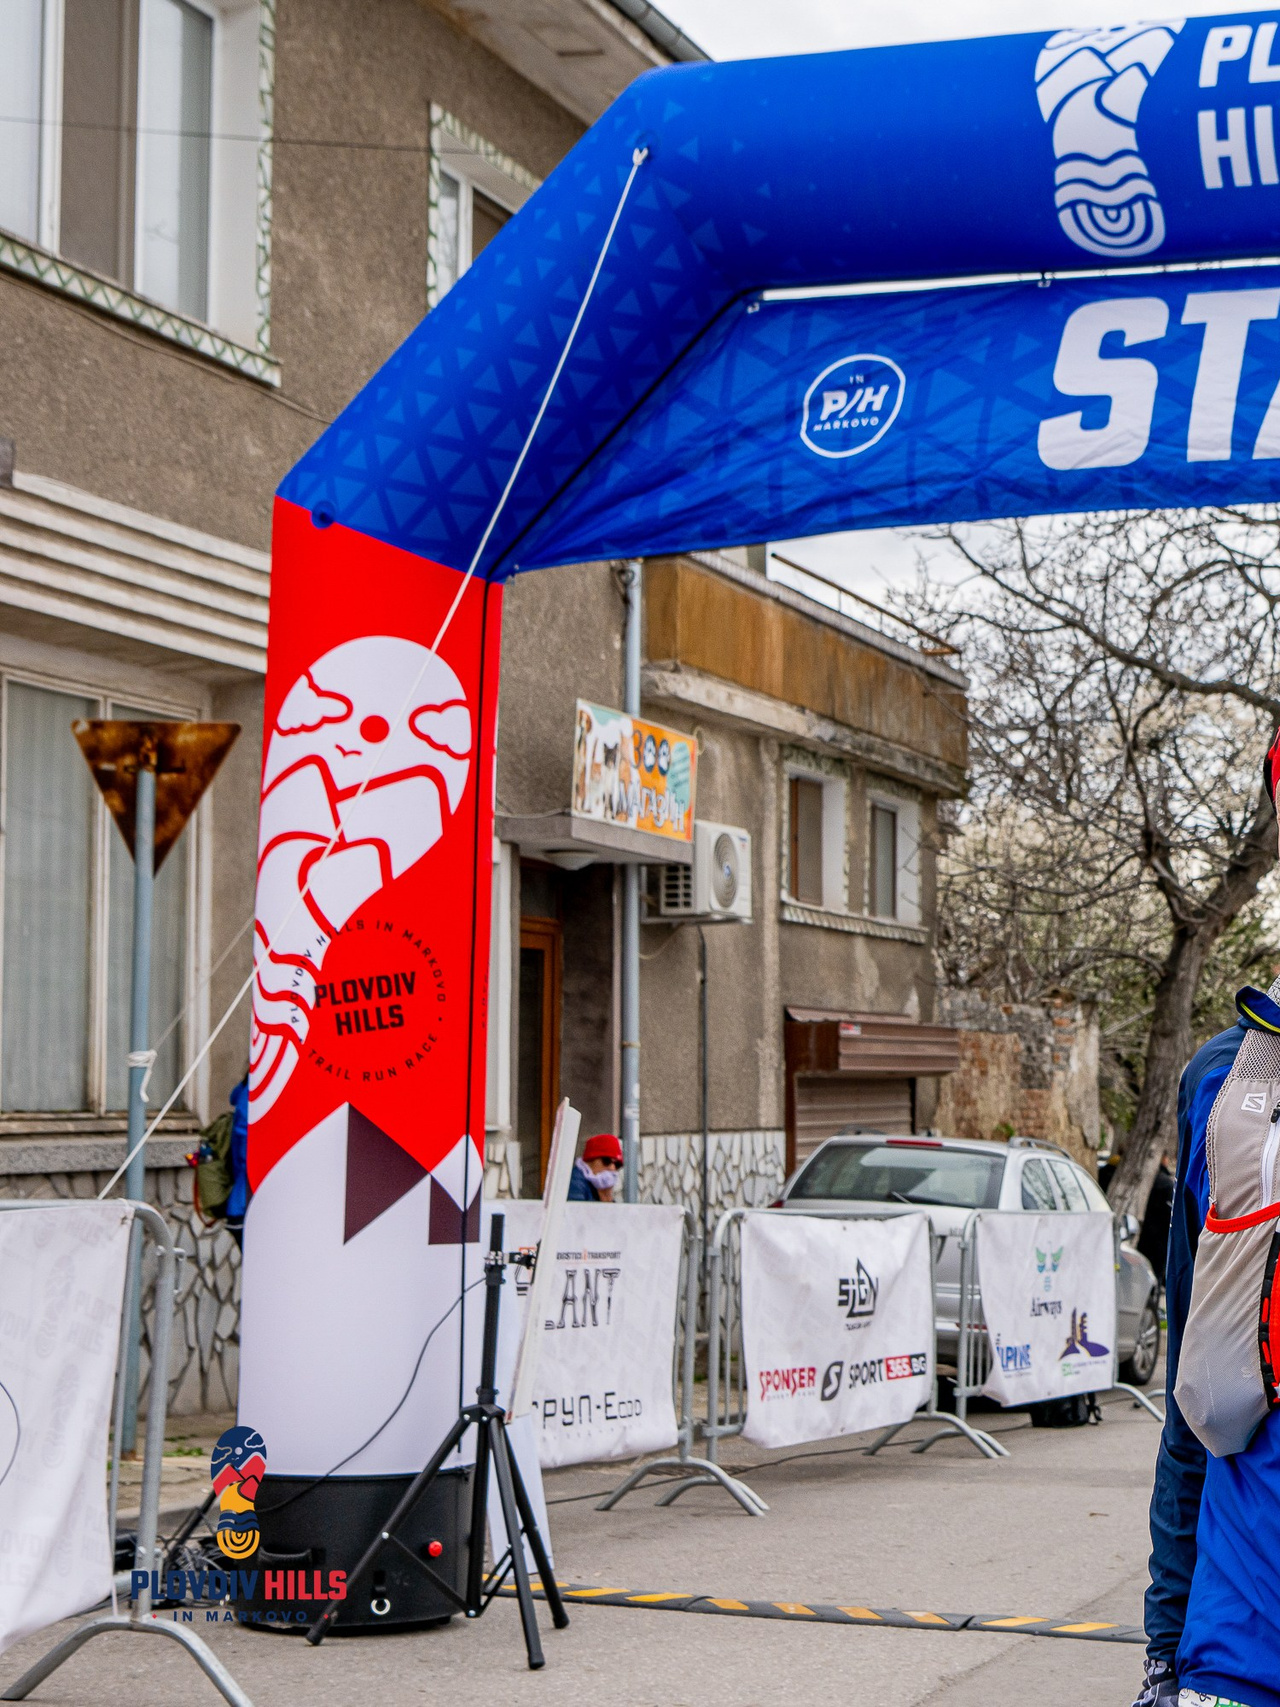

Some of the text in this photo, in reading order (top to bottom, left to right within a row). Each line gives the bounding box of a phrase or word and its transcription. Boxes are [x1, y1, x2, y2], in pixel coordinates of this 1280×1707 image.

[820, 384, 890, 421] P/H
[813, 416, 879, 432] MARKOVO
[376, 919, 394, 932] IN
[402, 929, 447, 1002] MARKOVO
[313, 971, 416, 1008] PLOVDIV
[335, 1004, 404, 1036] HILLS
[308, 1032, 437, 1082] TRAIL RUN RACE
[544, 1267, 621, 1330] ANT
